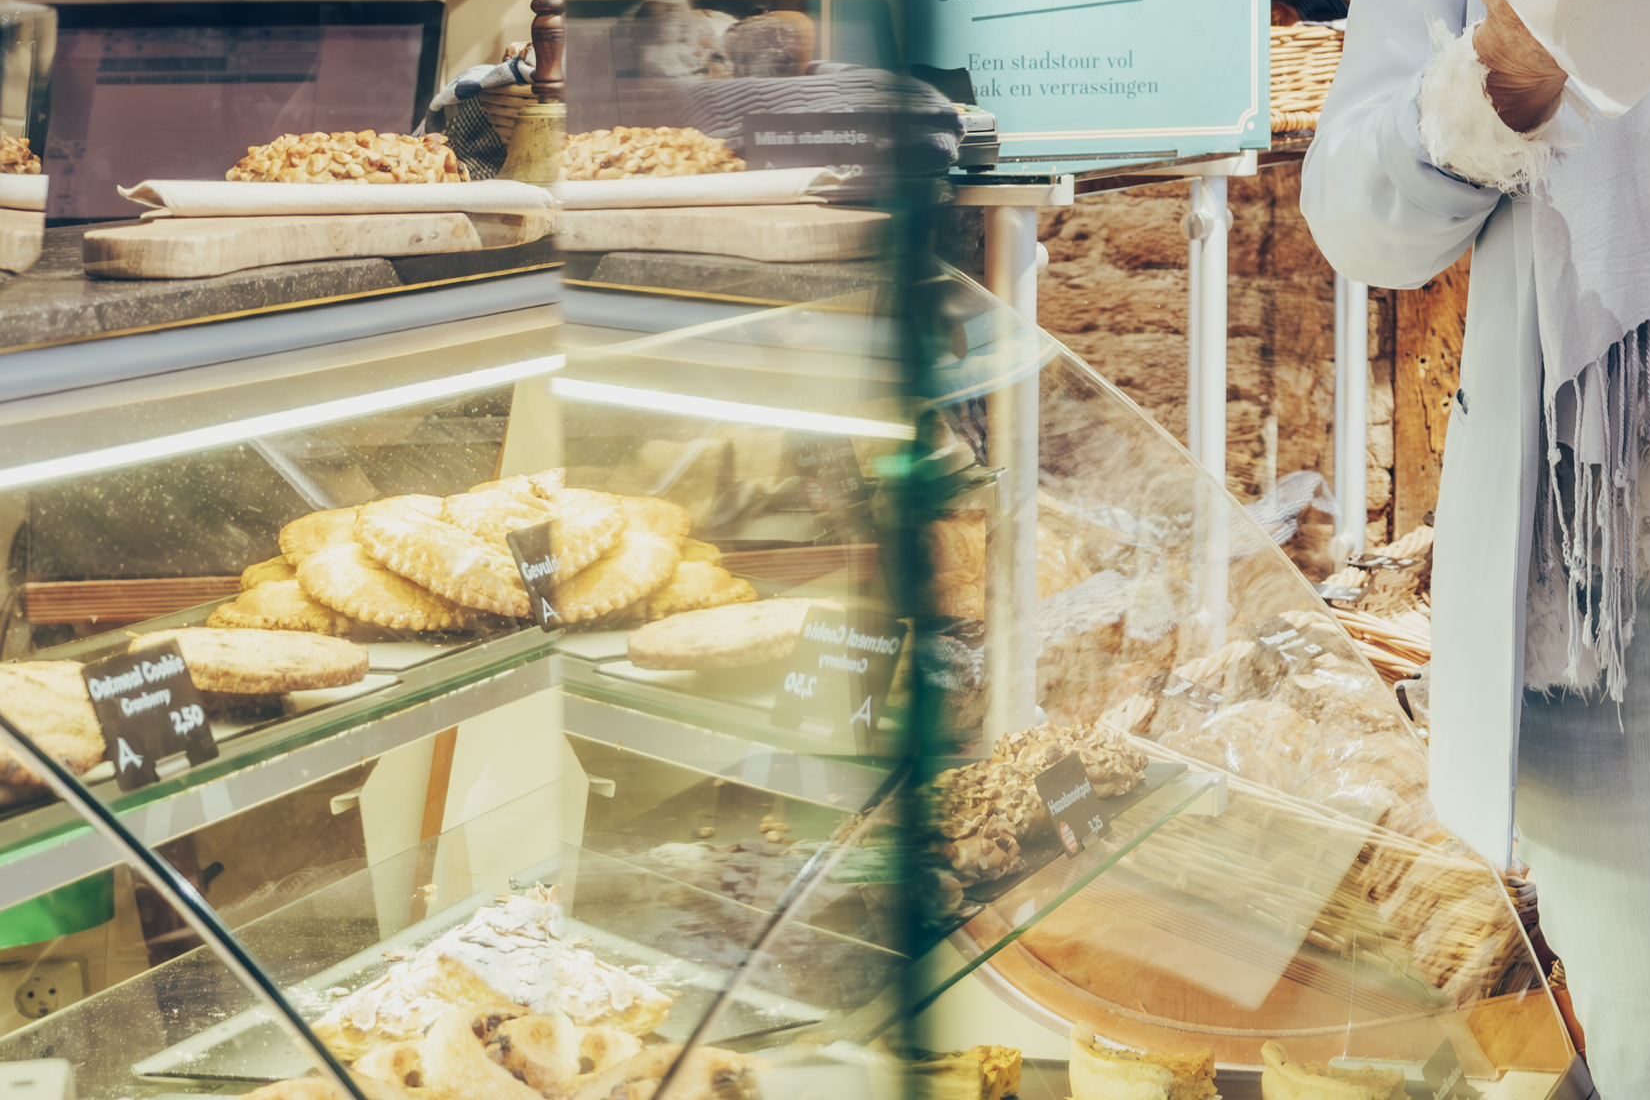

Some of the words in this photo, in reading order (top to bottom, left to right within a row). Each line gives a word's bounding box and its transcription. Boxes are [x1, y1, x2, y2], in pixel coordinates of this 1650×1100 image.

[967, 53, 1005, 71] Een
[1010, 50, 1101, 71] stadstour
[1106, 49, 1134, 69] vol
[1009, 83, 1032, 97] en
[1039, 77, 1159, 100] verrassingen
[754, 130, 795, 146] Mini
[88, 664, 144, 702] Oatmeal
[141, 653, 186, 683] Cookie
[120, 689, 172, 717] Cranberry
[169, 704, 204, 736] 2,50
